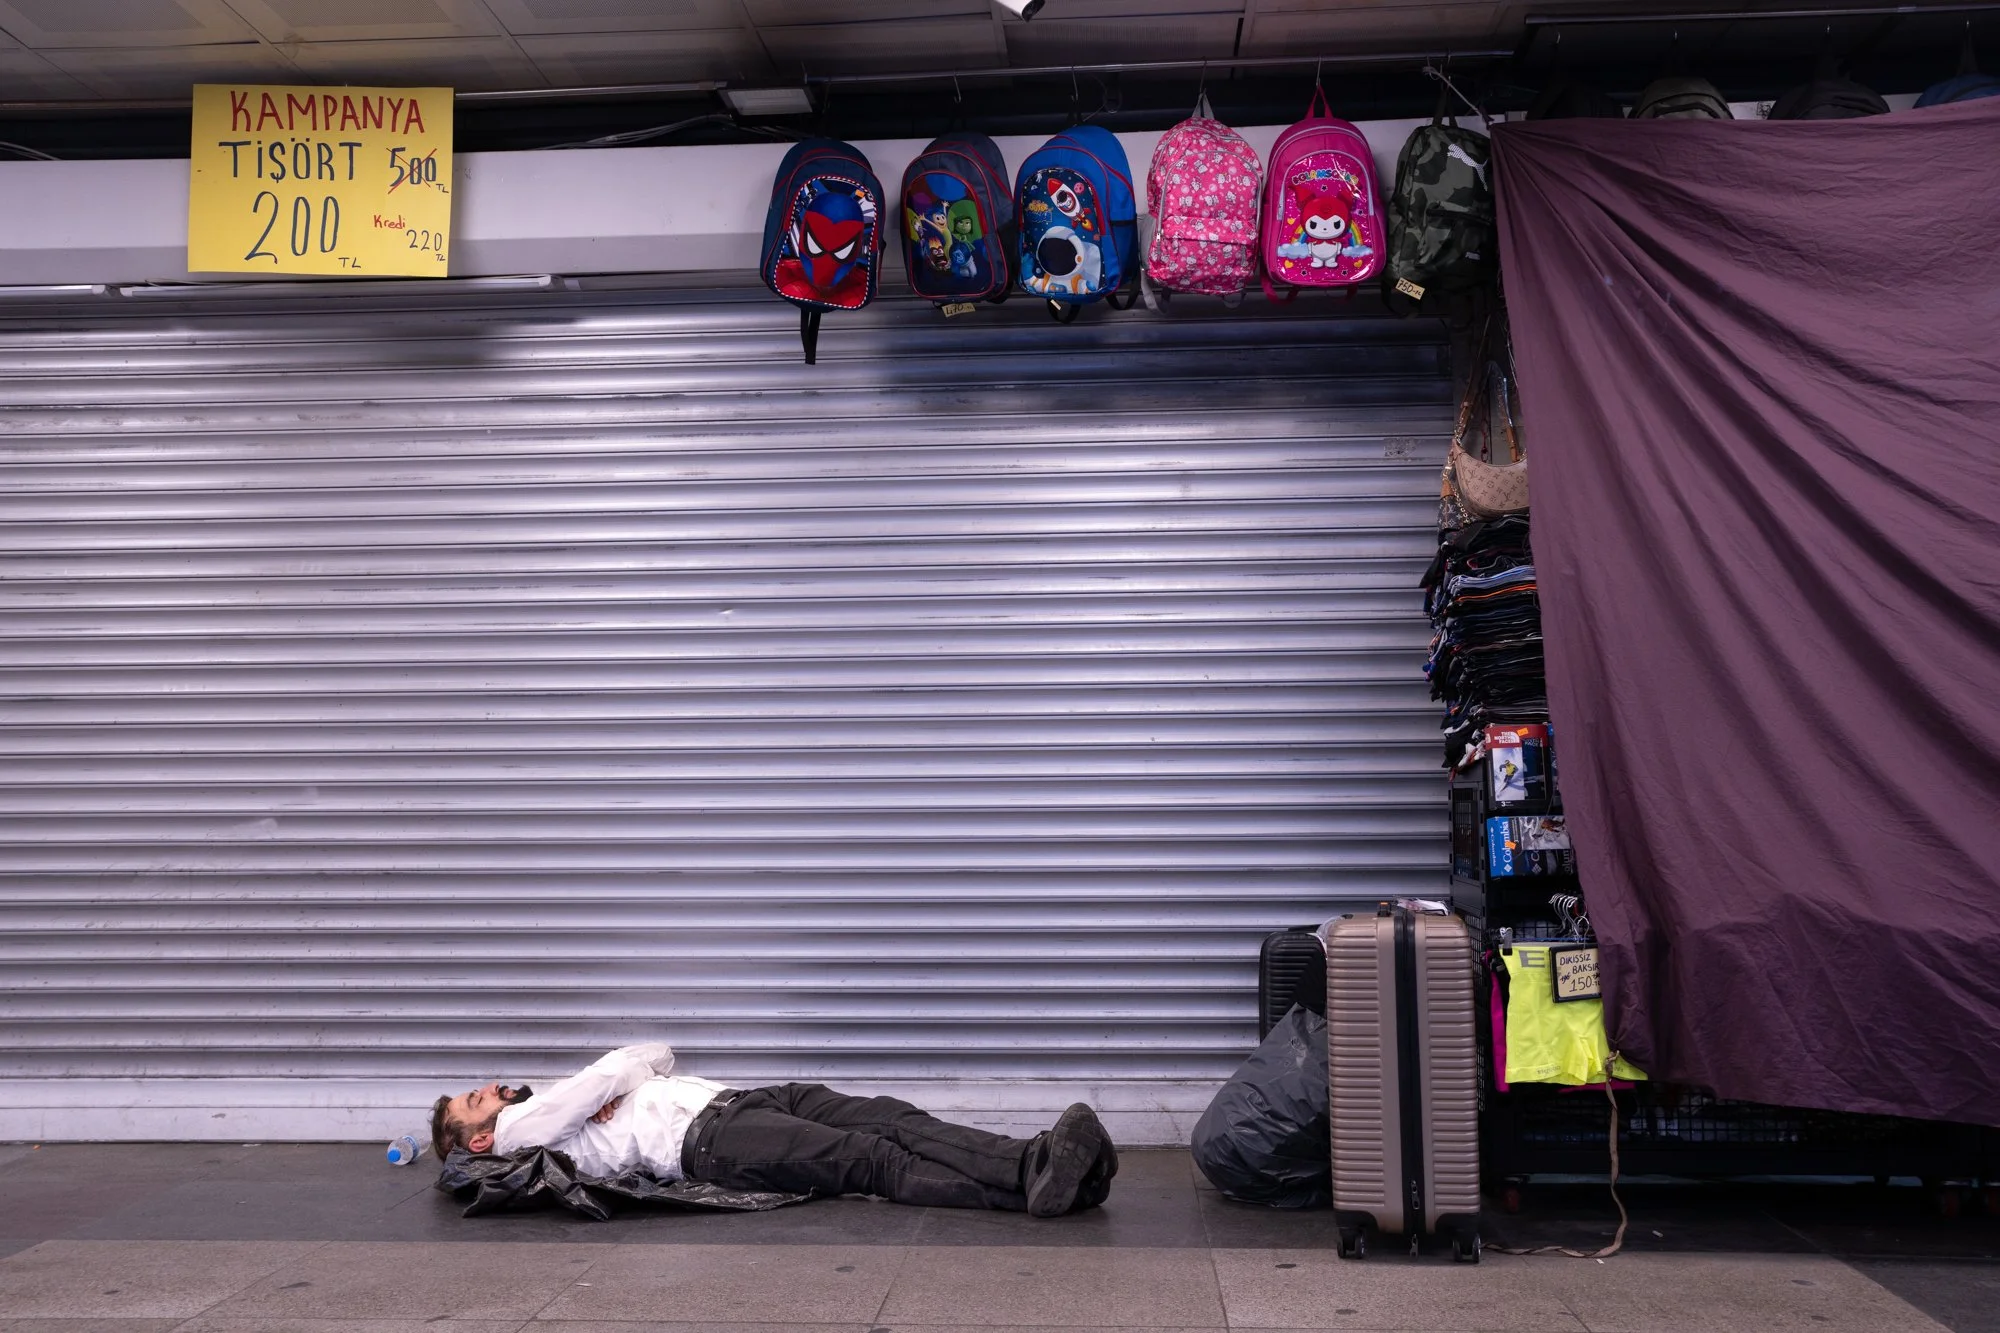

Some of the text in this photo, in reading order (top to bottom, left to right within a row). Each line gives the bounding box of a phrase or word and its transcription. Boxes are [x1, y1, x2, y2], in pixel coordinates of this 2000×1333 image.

[230, 90, 425, 134] KAMPANYA
[218, 137, 362, 184] TİŞÖRT
[389, 146, 449, 194] 500 TL
[244, 191, 362, 269] 200 TL
[373, 214, 406, 230] Kredi
[406, 229, 443, 252] 220
[435, 253, 446, 262] TL
[1500, 821, 1513, 863] Colmbia
